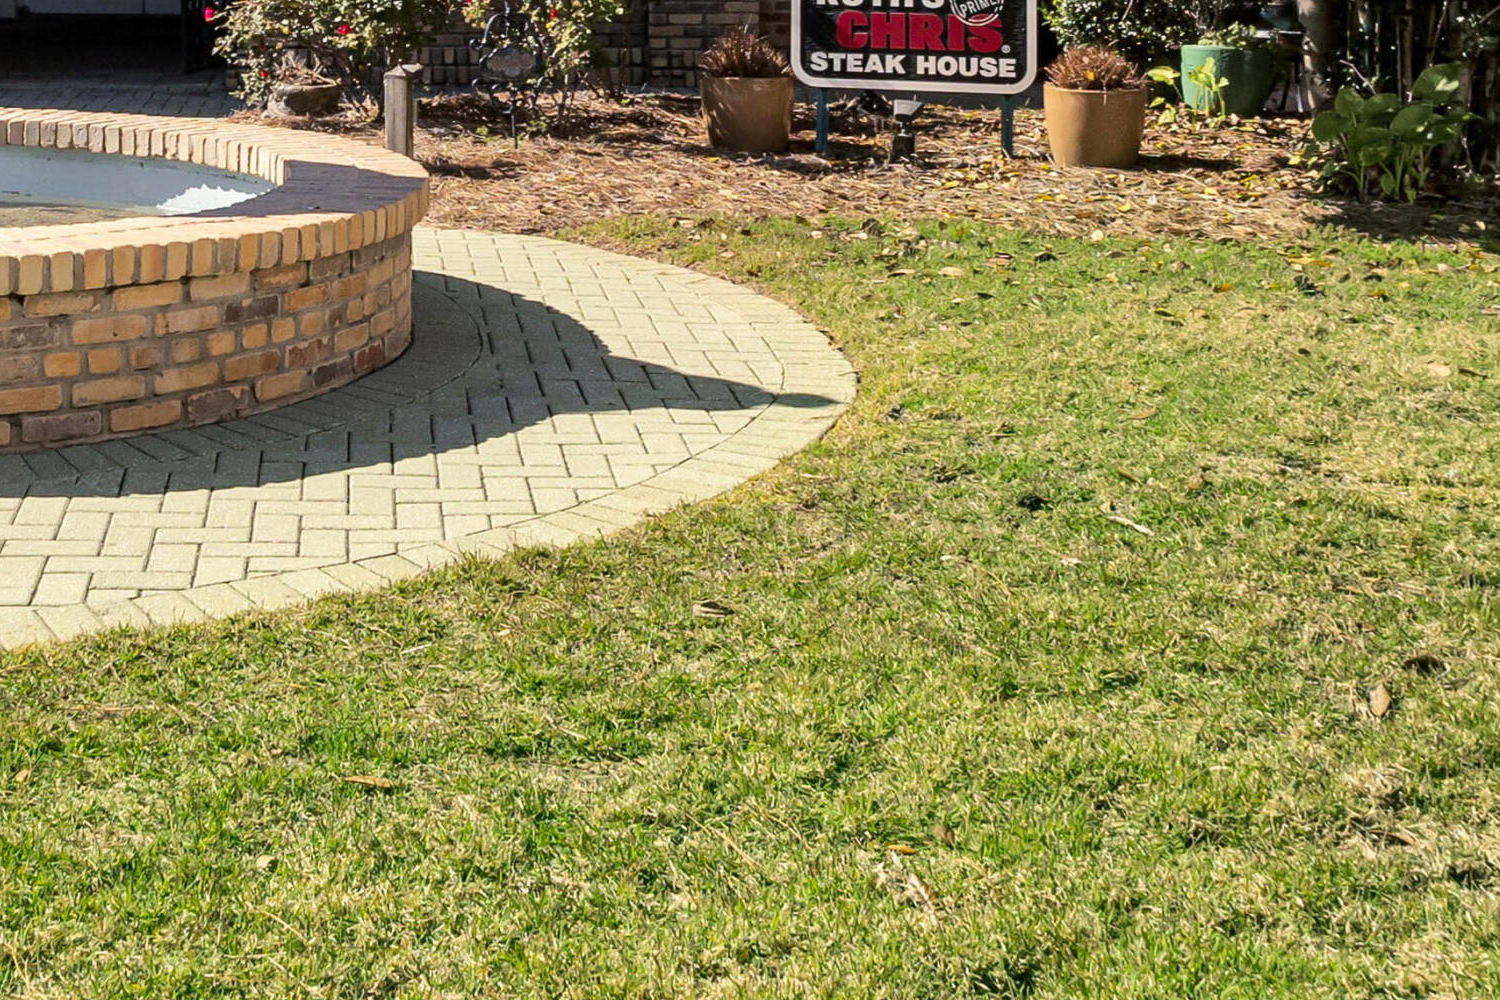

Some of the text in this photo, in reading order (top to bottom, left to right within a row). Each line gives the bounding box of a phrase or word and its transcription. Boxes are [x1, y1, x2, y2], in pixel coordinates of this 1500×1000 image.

[836, 9, 1004, 53] CHRIS
[810, 52, 1018, 78] STEAK HOUSE
